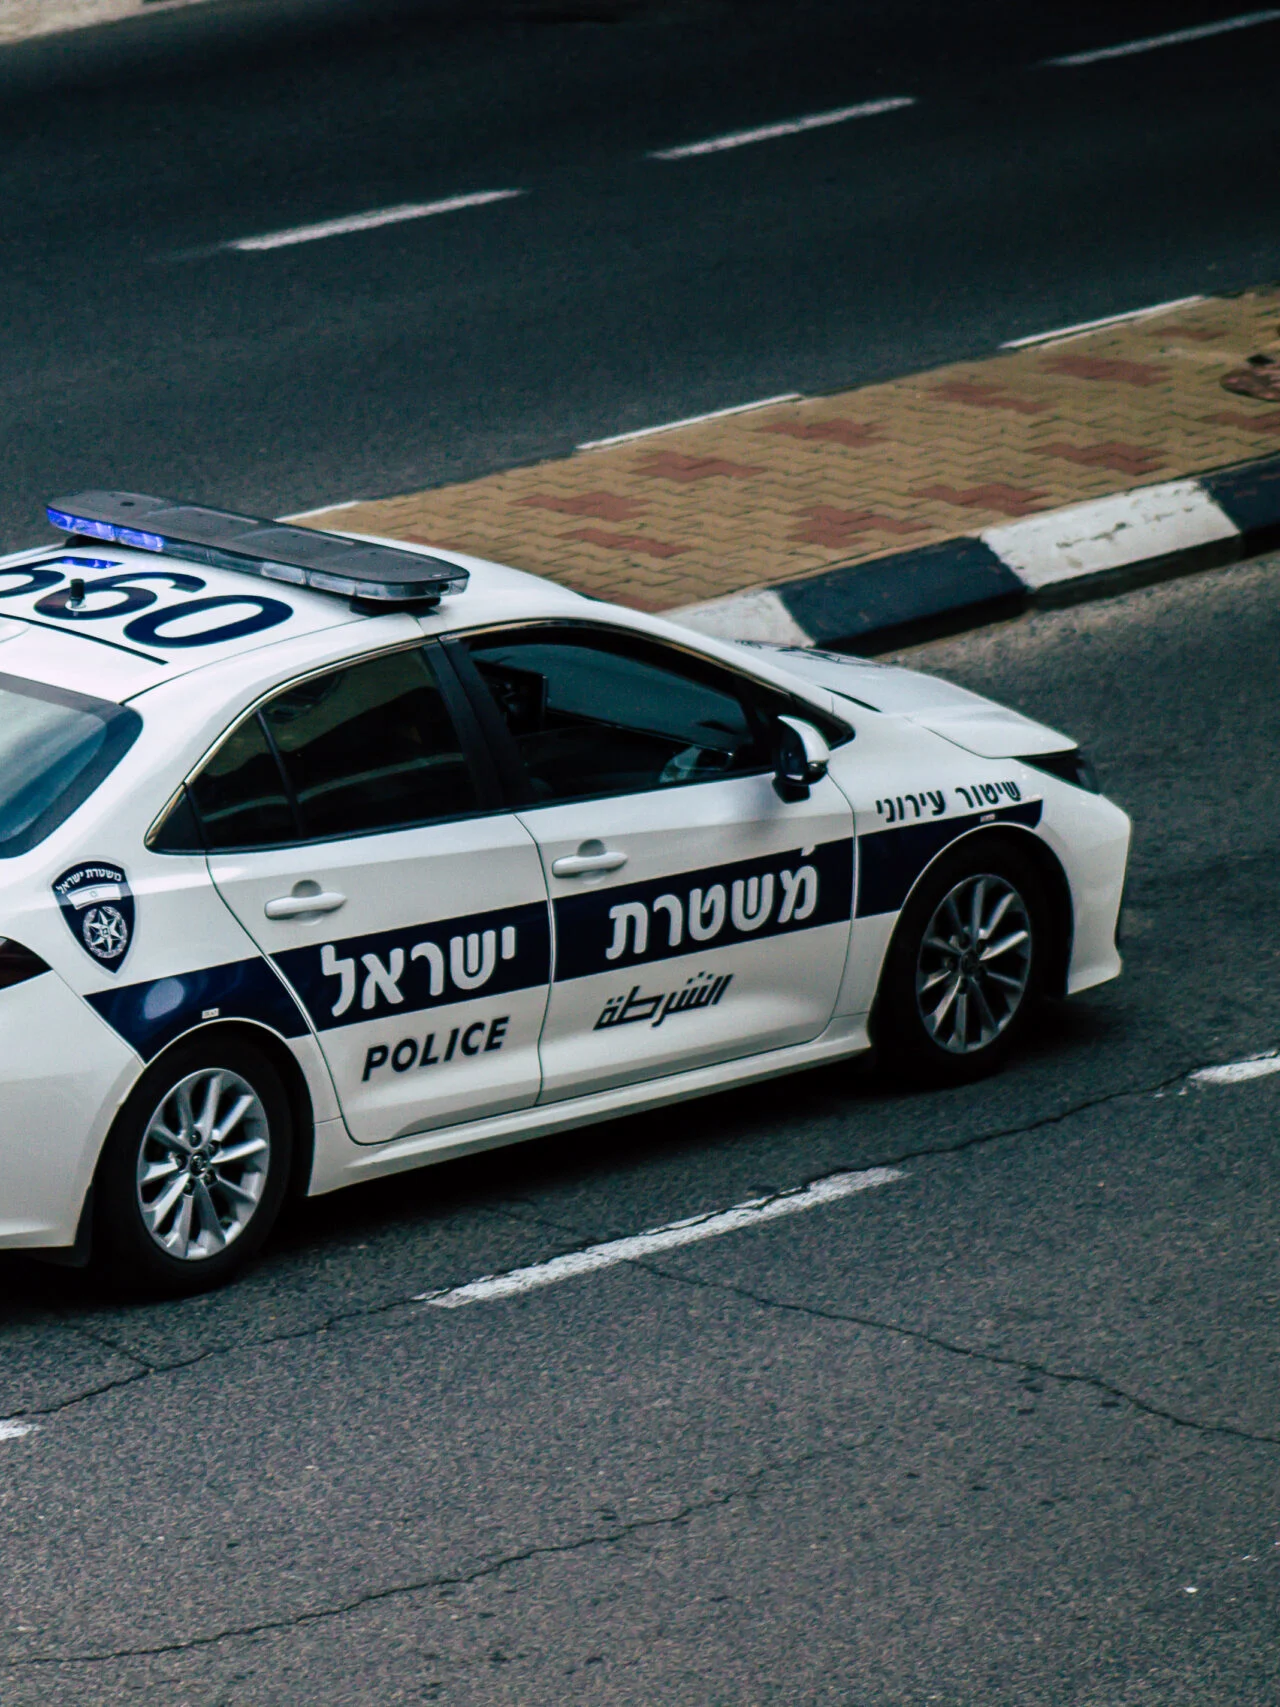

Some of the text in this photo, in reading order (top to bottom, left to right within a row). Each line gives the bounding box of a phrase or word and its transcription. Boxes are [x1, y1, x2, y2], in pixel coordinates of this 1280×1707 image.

[875, 780, 1022, 824] שיטור עירוני
[55, 867, 123, 895] משטרת ישראל
[320, 846, 818, 1017] משטרת ישראל
[592, 970, 734, 1031] الشرطة
[360, 1015, 511, 1082] POLICE
